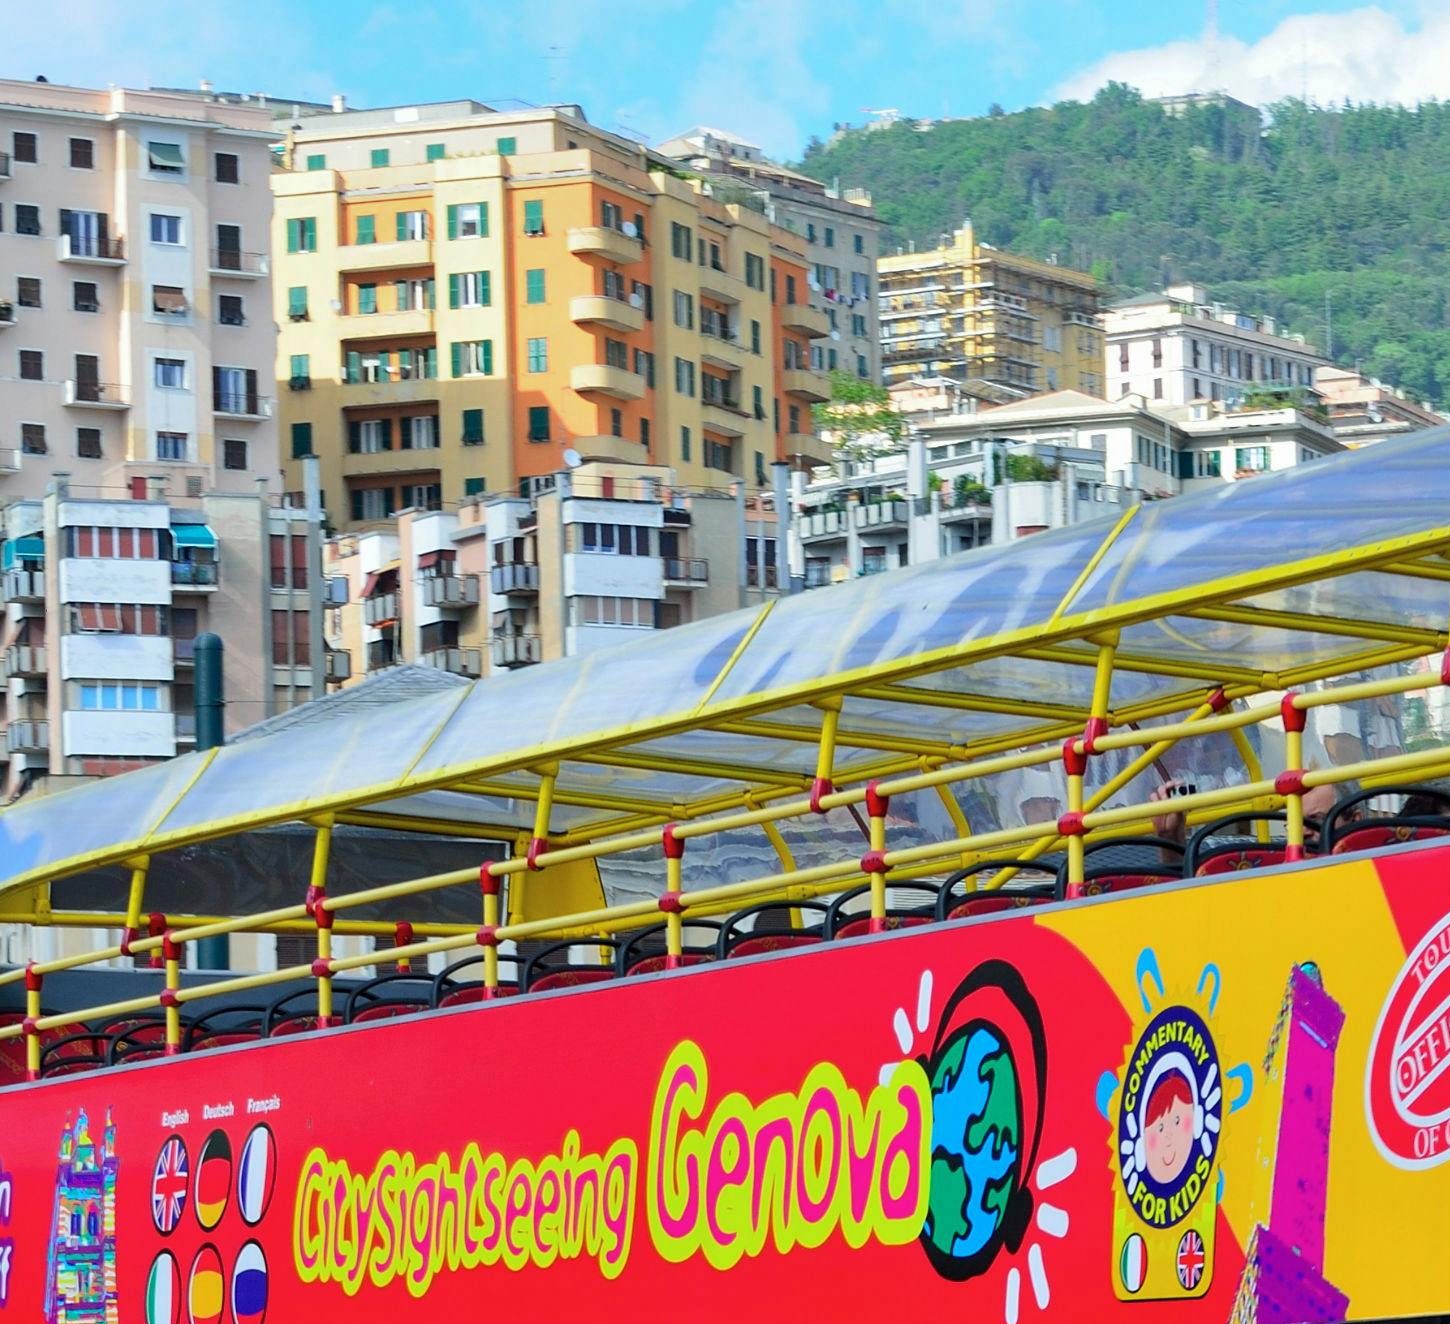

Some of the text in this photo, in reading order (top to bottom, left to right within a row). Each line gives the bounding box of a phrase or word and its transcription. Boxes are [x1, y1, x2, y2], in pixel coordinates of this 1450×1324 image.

[1125, 1020, 1209, 1112] COMMENTARY
[161, 1109, 190, 1128] English
[203, 1101, 235, 1120] Deutsch
[246, 1094, 281, 1114] Français
[646, 1039, 932, 1270] Genova
[1413, 1124, 1443, 1158] OF
[1132, 1154, 1210, 1225] FOR KIDS
